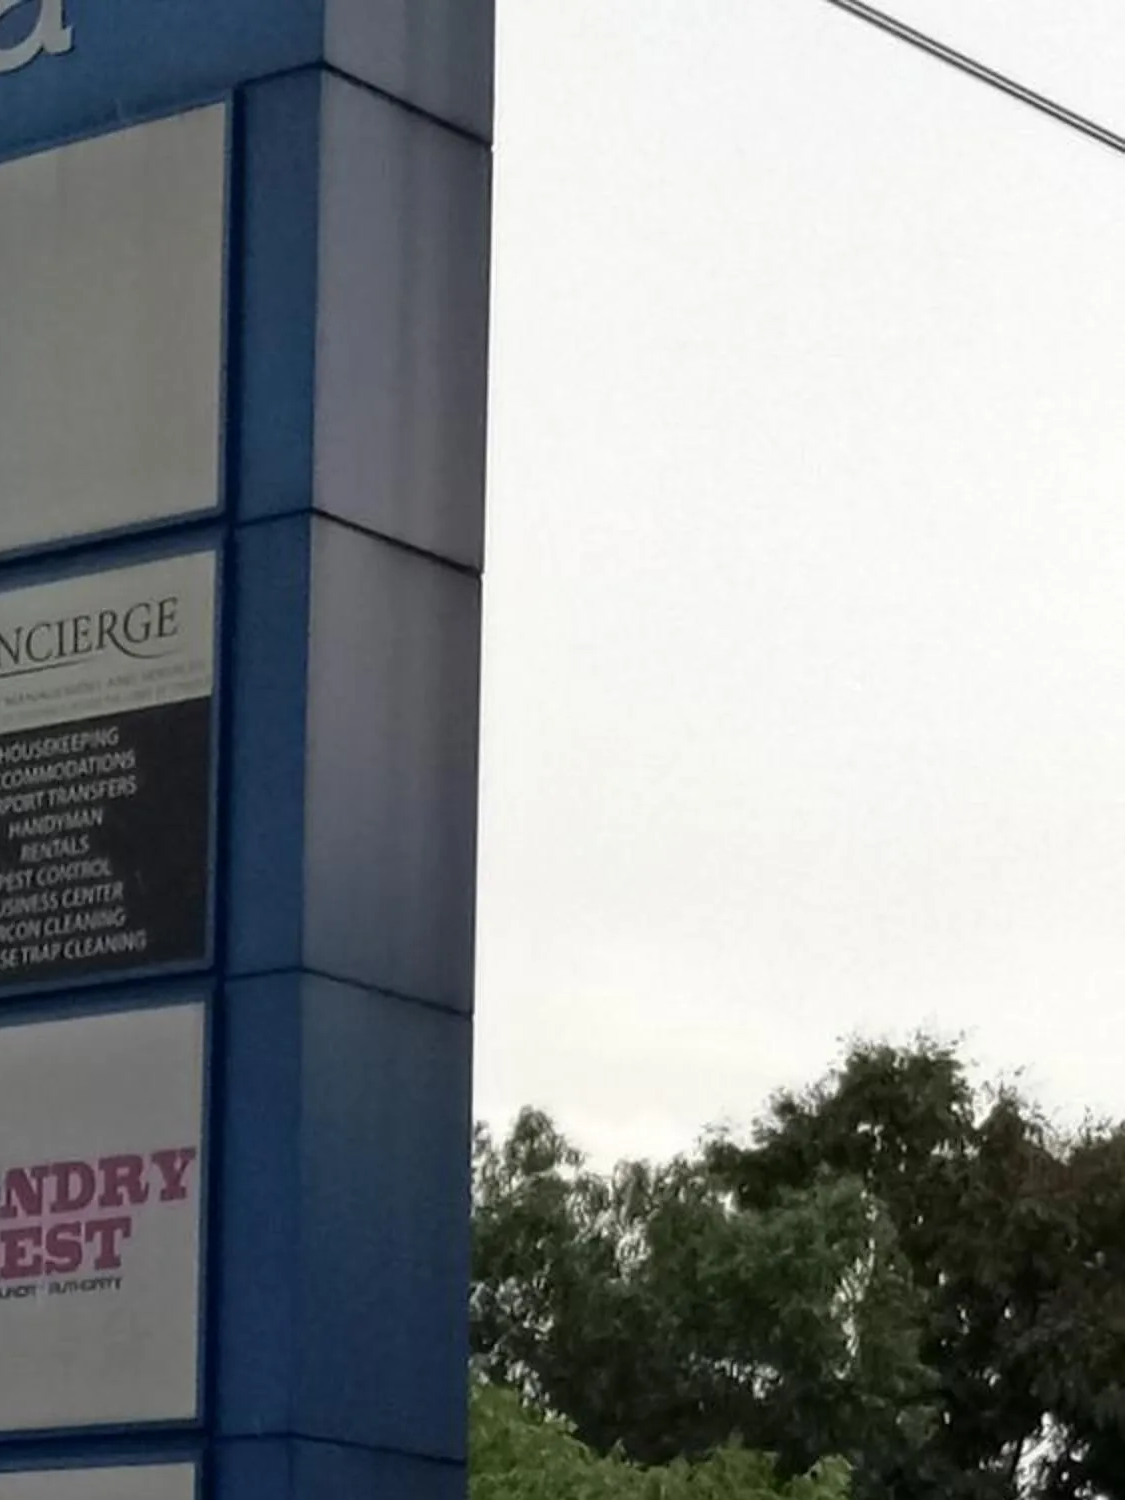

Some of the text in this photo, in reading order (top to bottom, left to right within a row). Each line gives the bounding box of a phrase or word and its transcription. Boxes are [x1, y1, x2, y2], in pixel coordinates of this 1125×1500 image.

[48, 775, 138, 808] TRANSFERS
[7, 807, 104, 840] HANDYMAN
[20, 834, 91, 862] RENTALS
[36, 857, 113, 886] CONTROL
[62, 880, 124, 909] CENTER
[43, 906, 127, 936] CLEANING
[21, 941, 62, 965] TRAP
[63, 928, 147, 960] CLEANING
